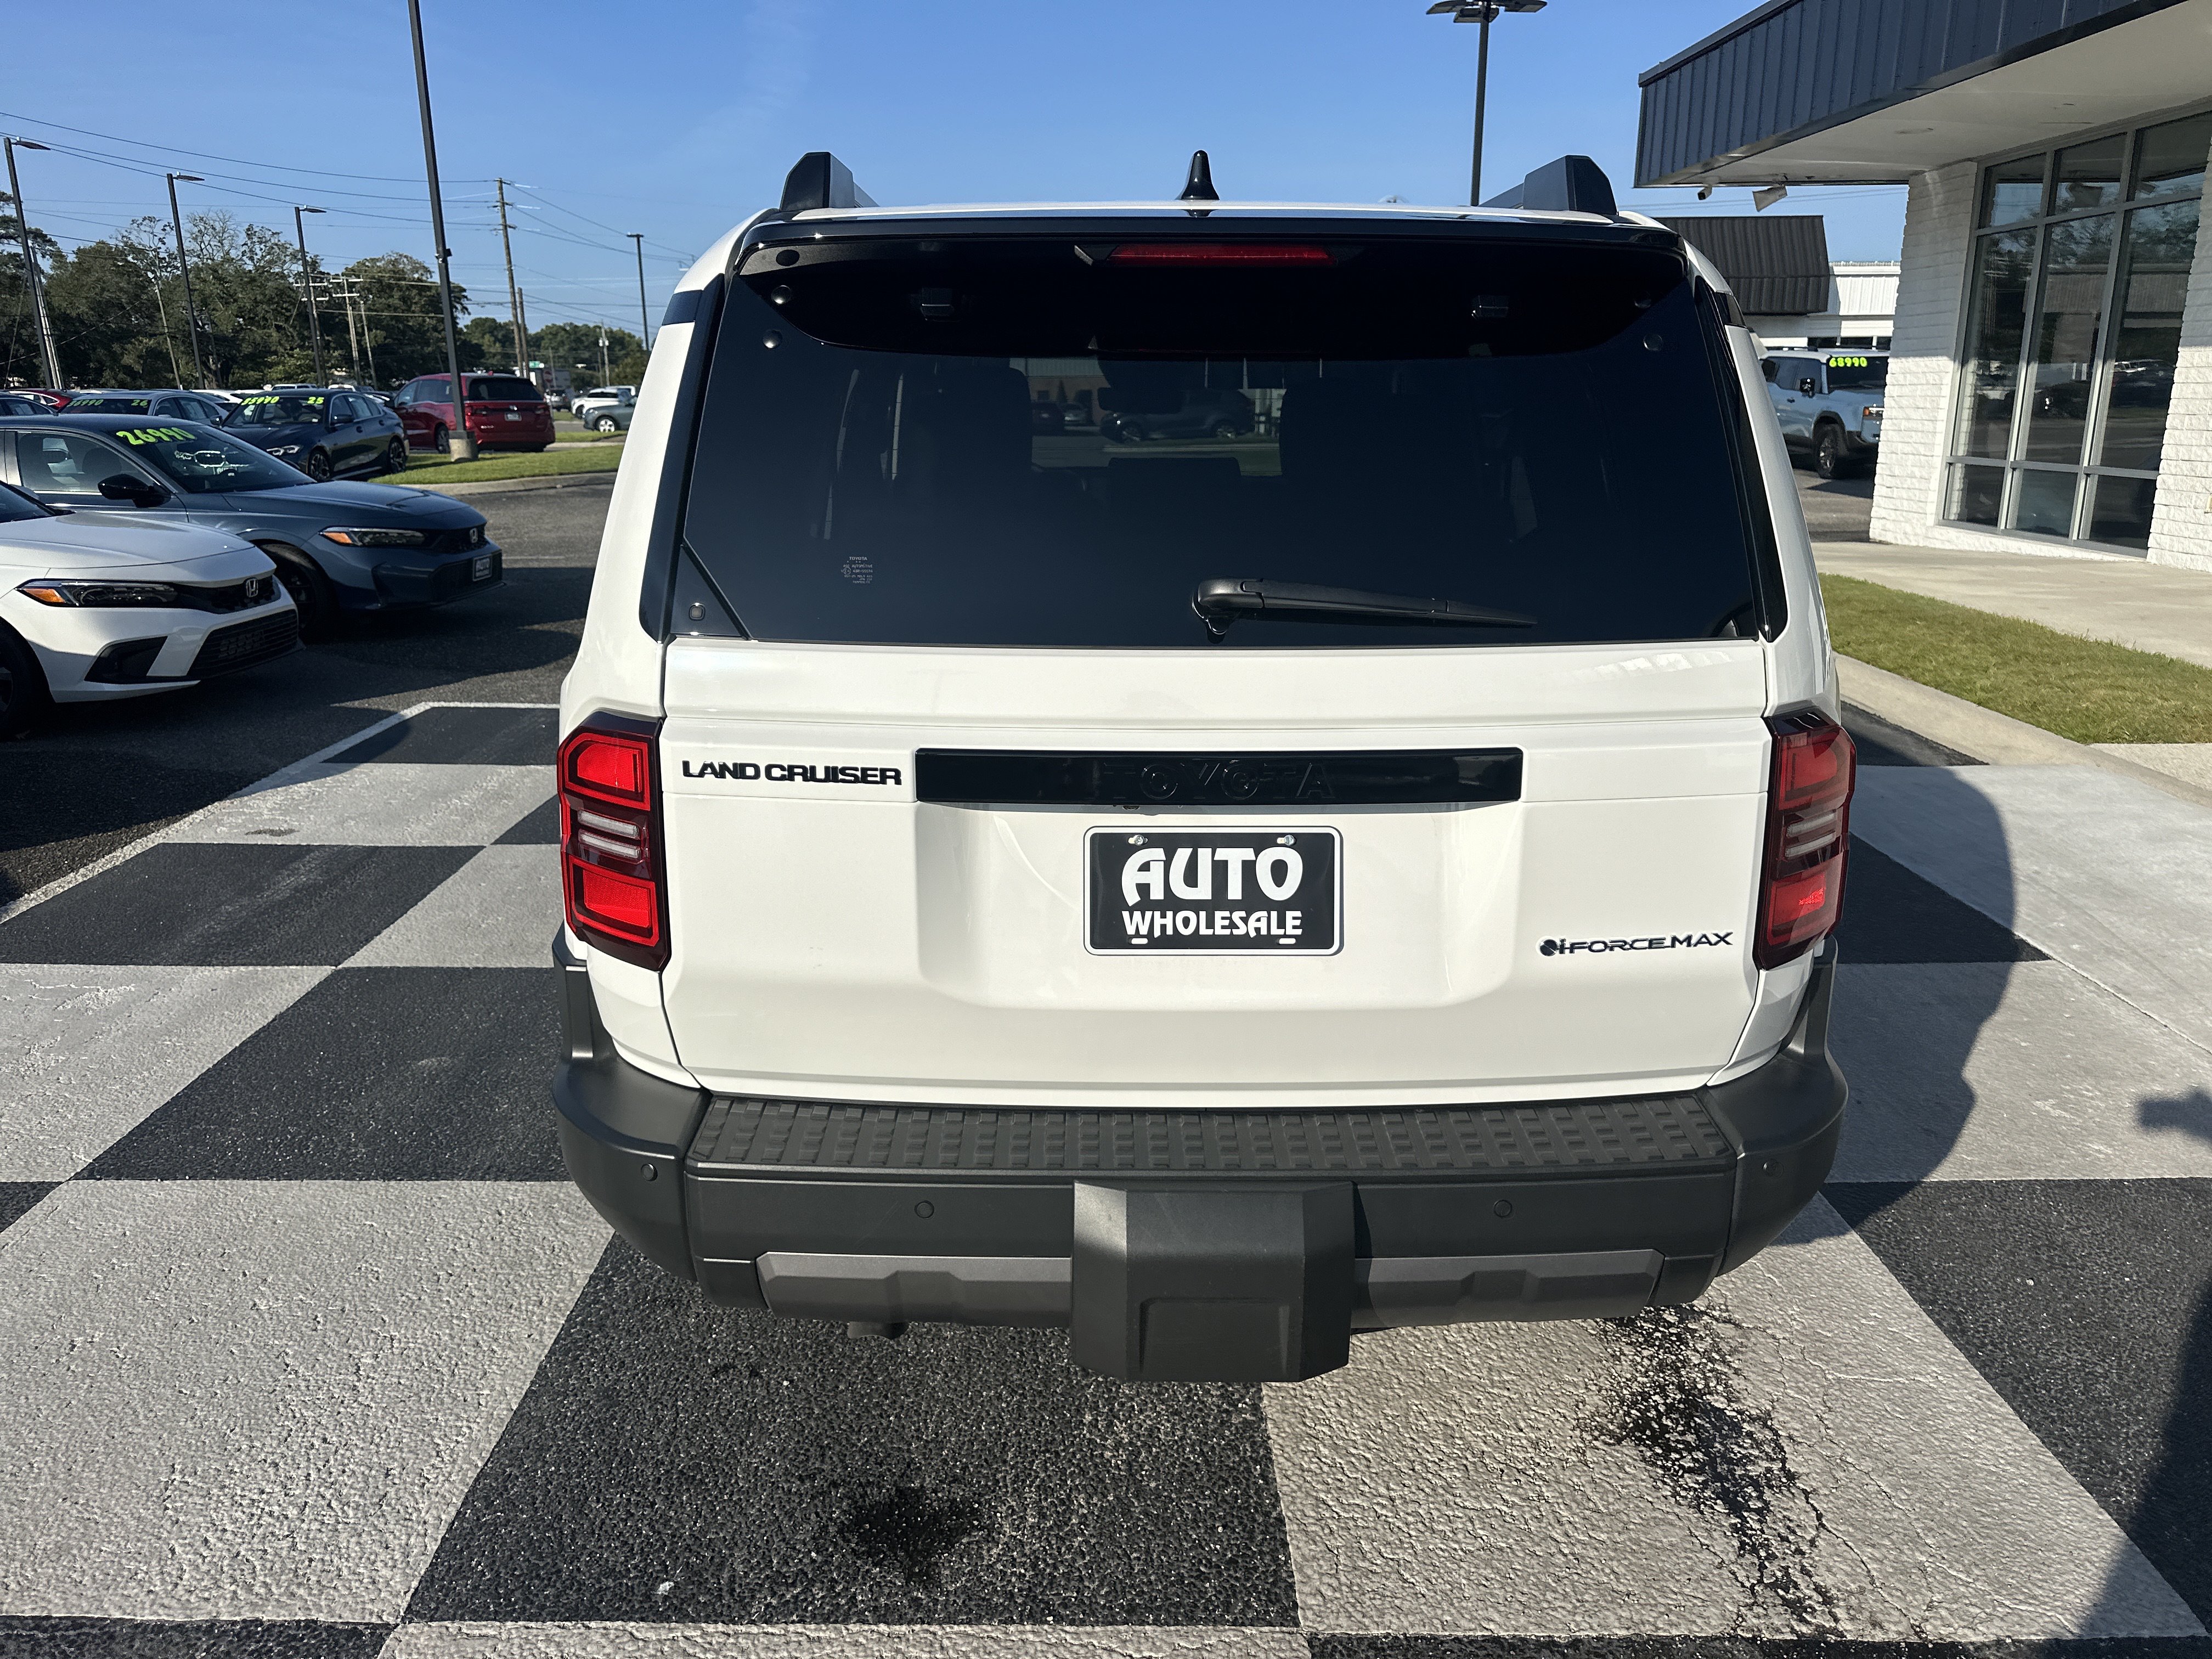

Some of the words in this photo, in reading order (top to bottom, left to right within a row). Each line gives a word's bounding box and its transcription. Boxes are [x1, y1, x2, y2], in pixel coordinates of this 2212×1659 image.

[1829, 357, 1867, 367] 68990
[116, 427, 197, 445] 26990
[682, 760, 760, 780] LAND
[765, 763, 902, 786] CRUISER
[1102, 761, 1336, 800] TOYOTA
[1121, 847, 1304, 907] AUTO
[1121, 910, 1303, 938] WHOLESALE
[1670, 932, 1733, 949] MAX
